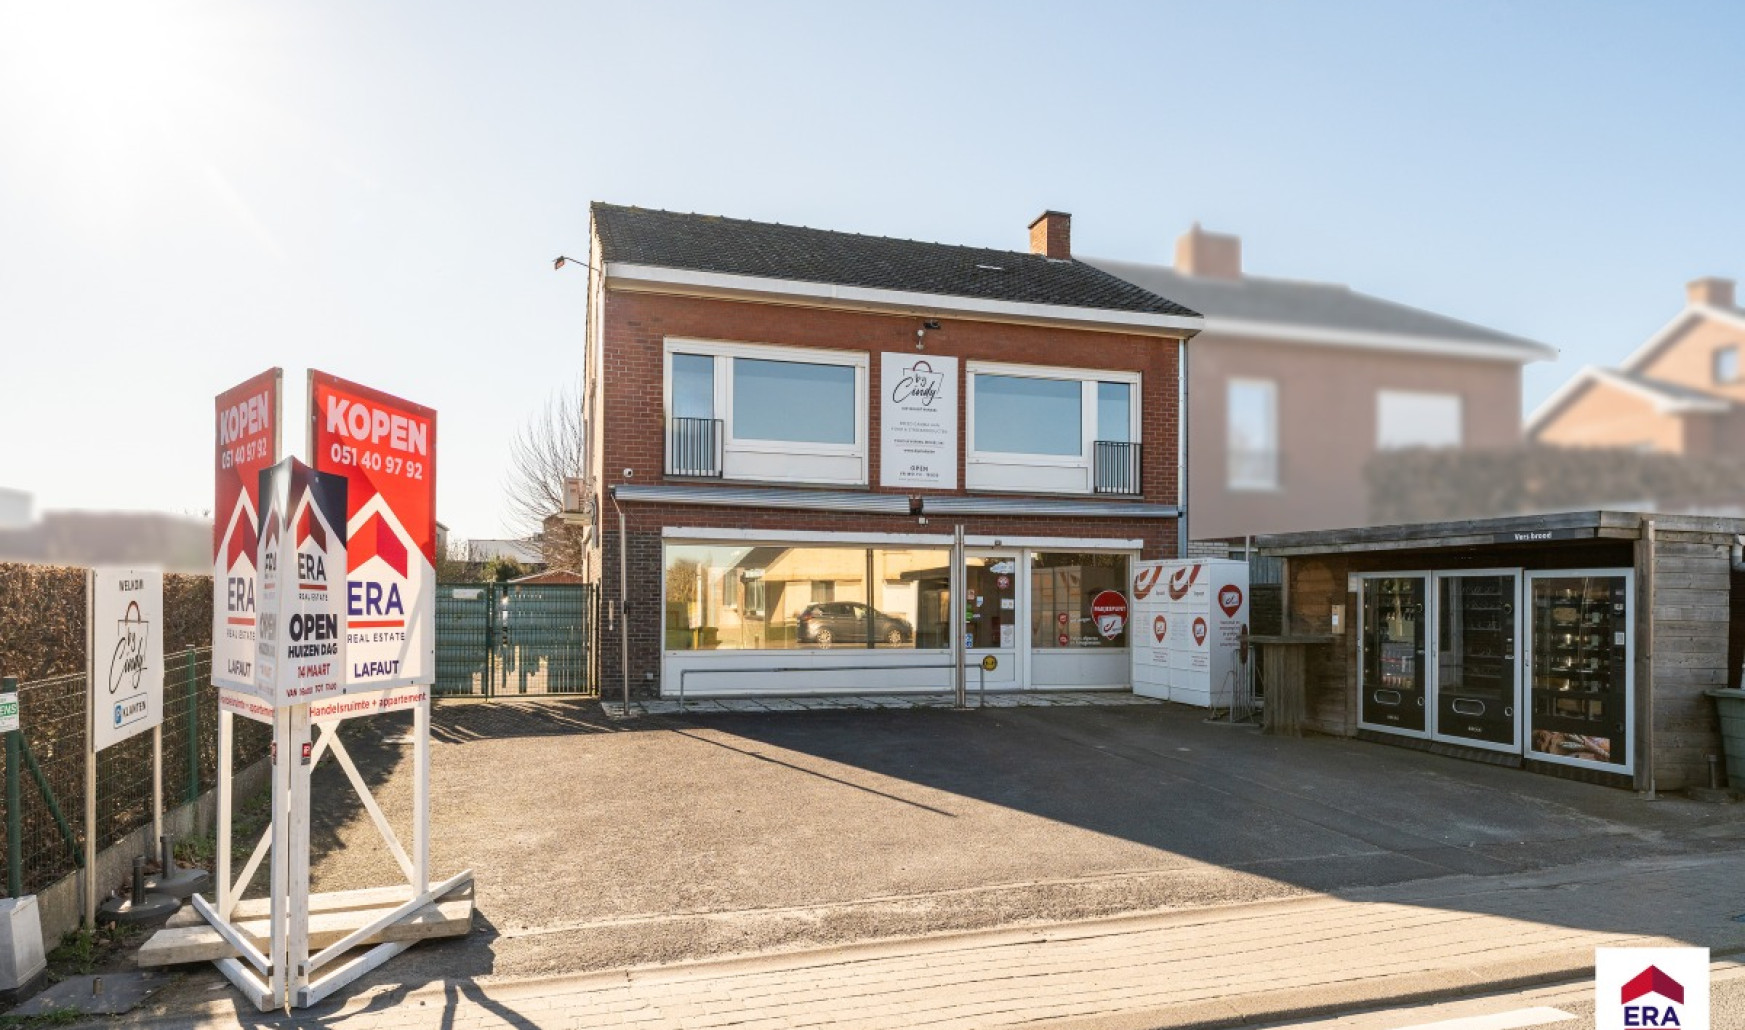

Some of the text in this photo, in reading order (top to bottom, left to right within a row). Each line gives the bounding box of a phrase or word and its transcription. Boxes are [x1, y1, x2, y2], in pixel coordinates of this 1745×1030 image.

[892, 377, 938, 406] Cindy
[220, 391, 269, 446] KOPEN
[326, 395, 427, 456] KOPEN
[222, 438, 267, 469] 051 40 97 92
[331, 443, 423, 480] 051 40 97 92
[1530, 530, 1552, 540] brood
[298, 552, 327, 581] ERA
[227, 577, 256, 612] ERA
[347, 581, 405, 616] ERA
[289, 613, 338, 642] OPEN
[347, 632, 405, 644] REAL ESTATE
[288, 644, 320, 659] HUIZEN
[320, 643, 338, 656] DAG
[228, 658, 251, 678] LAFAUT
[306, 663, 331, 678] MAART
[354, 660, 400, 678] LAFAUT
[309, 699, 370, 718] Handelsruimte
[379, 692, 427, 708] appartement
